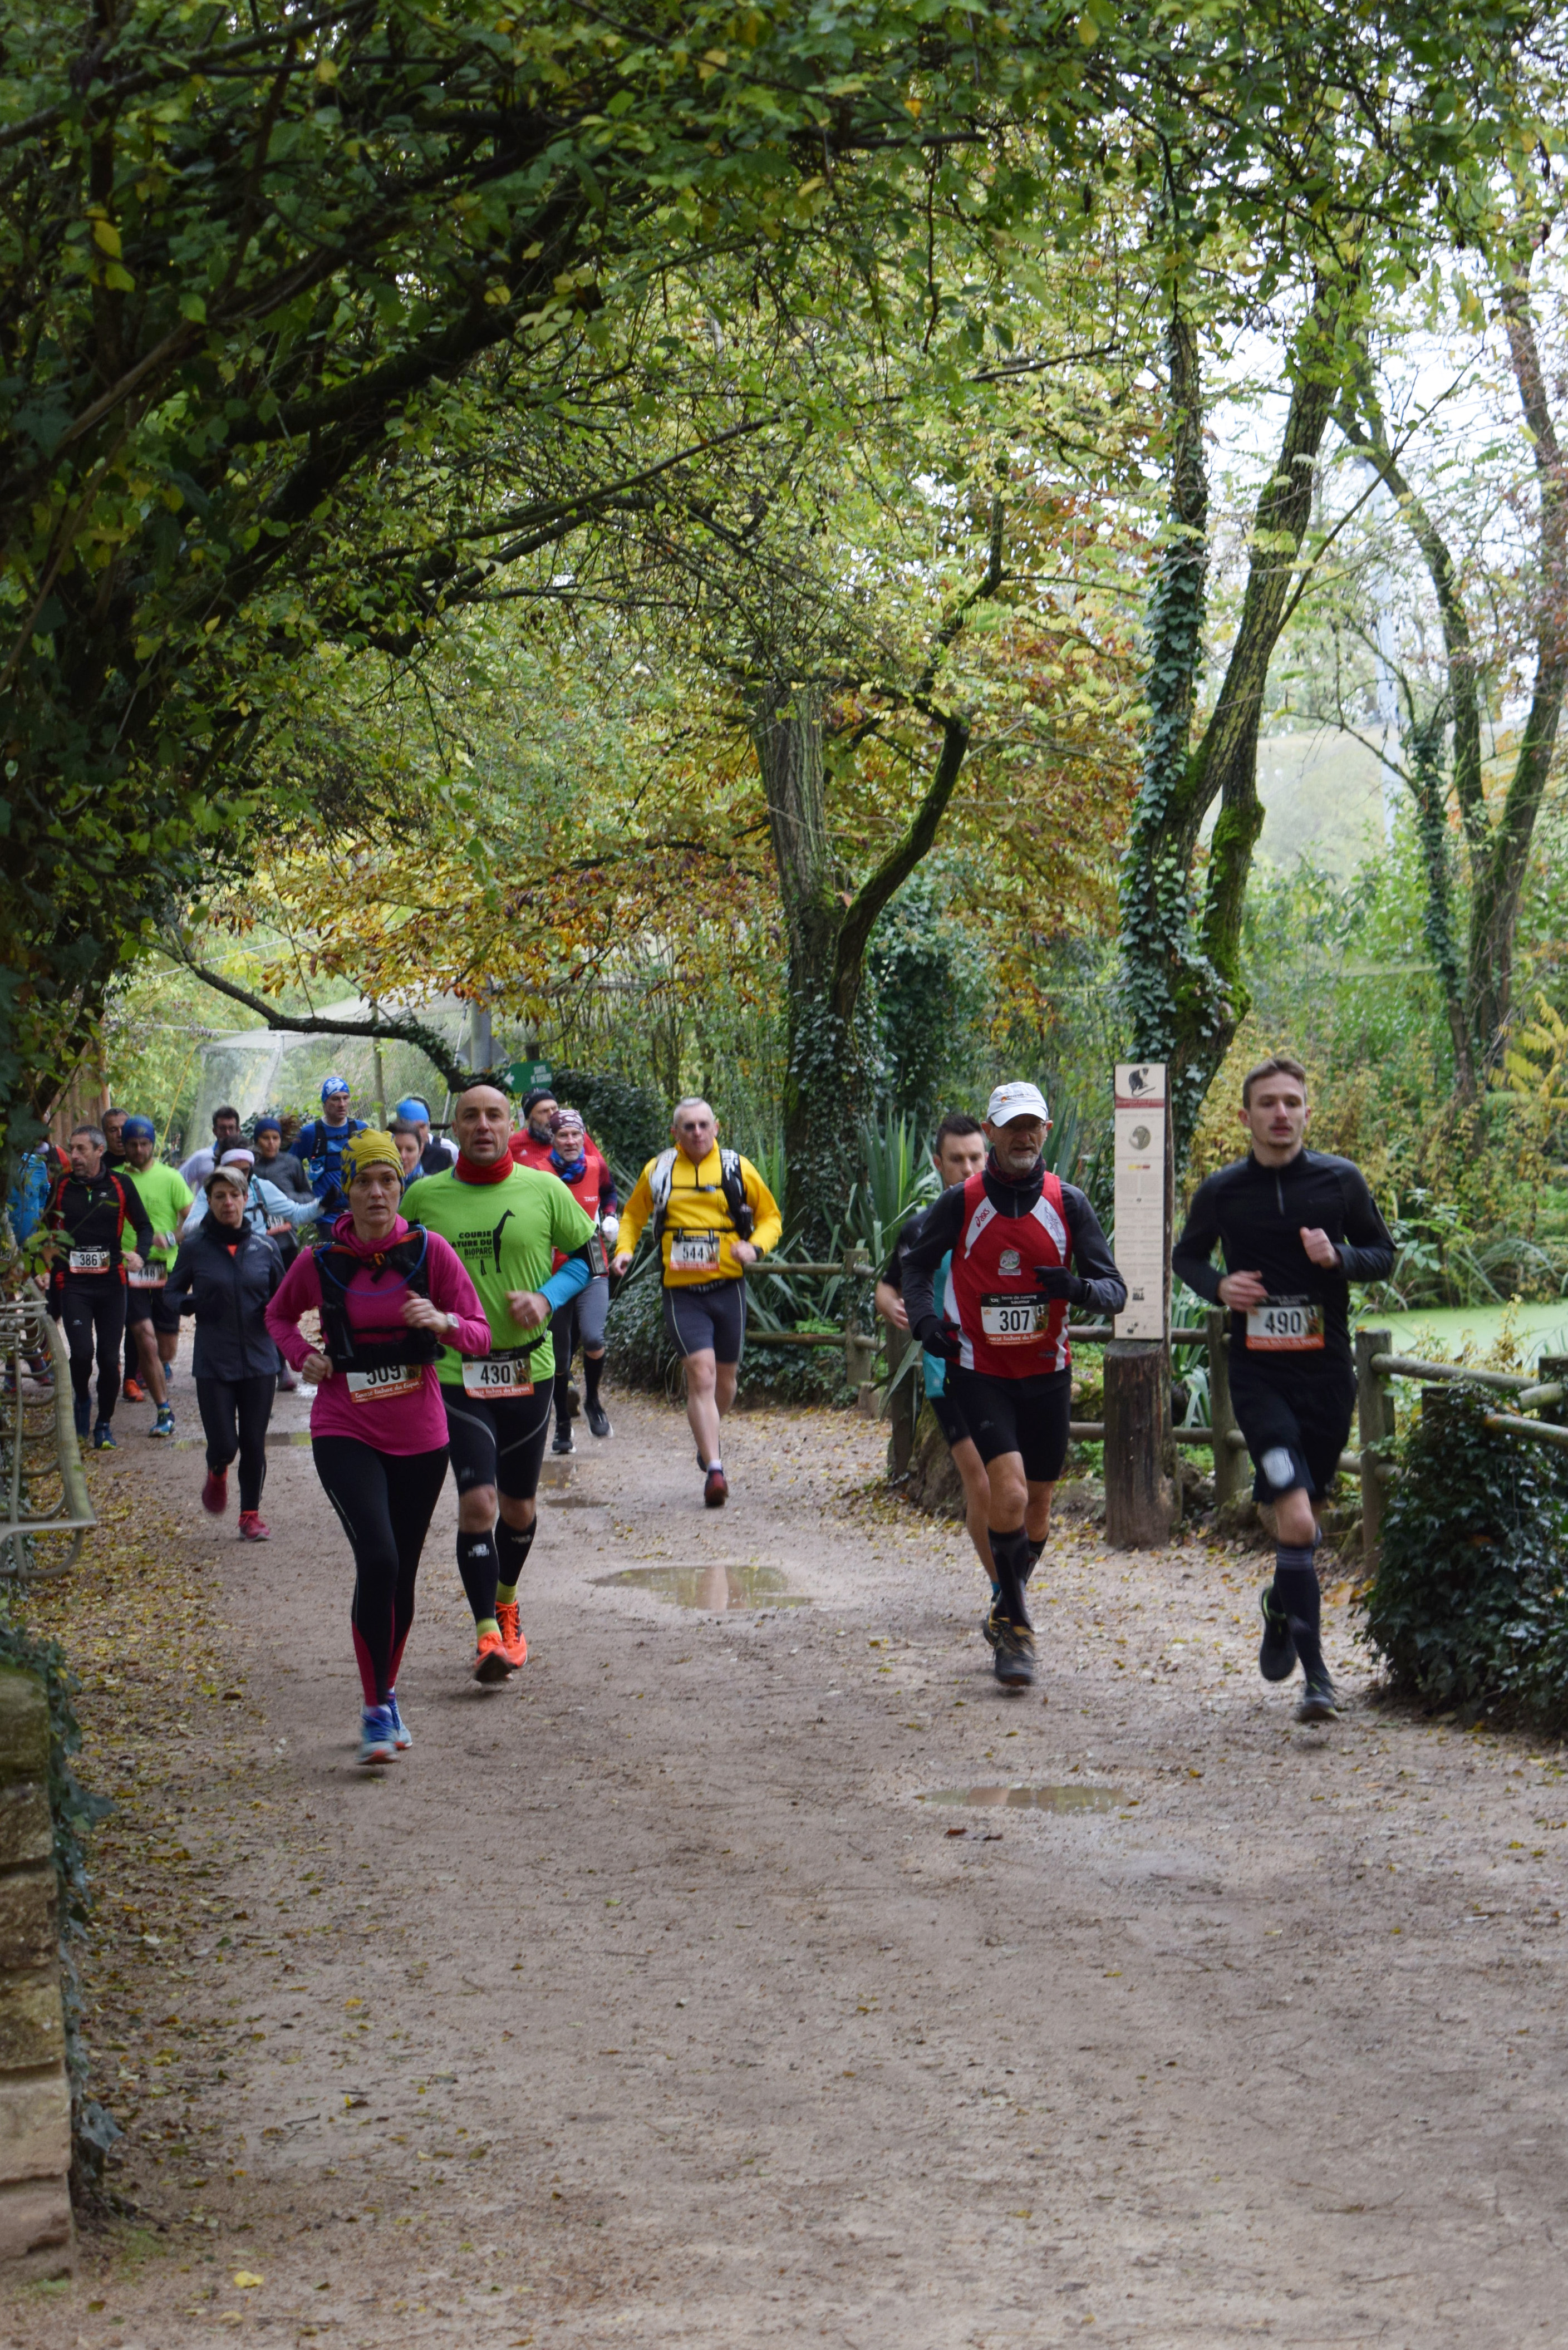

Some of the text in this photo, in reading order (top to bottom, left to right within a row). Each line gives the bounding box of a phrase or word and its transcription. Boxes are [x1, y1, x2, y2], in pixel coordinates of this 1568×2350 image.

[975, 1208, 990, 1227] asics
[459, 1231, 491, 1239] COURSE
[80, 1253, 97, 1266] 386
[682, 1245, 704, 1260] 544
[999, 1310, 1030, 1331] 307
[1265, 1311, 1301, 1334] 490
[366, 1365, 401, 1385] 509
[480, 1364, 512, 1384] 430
